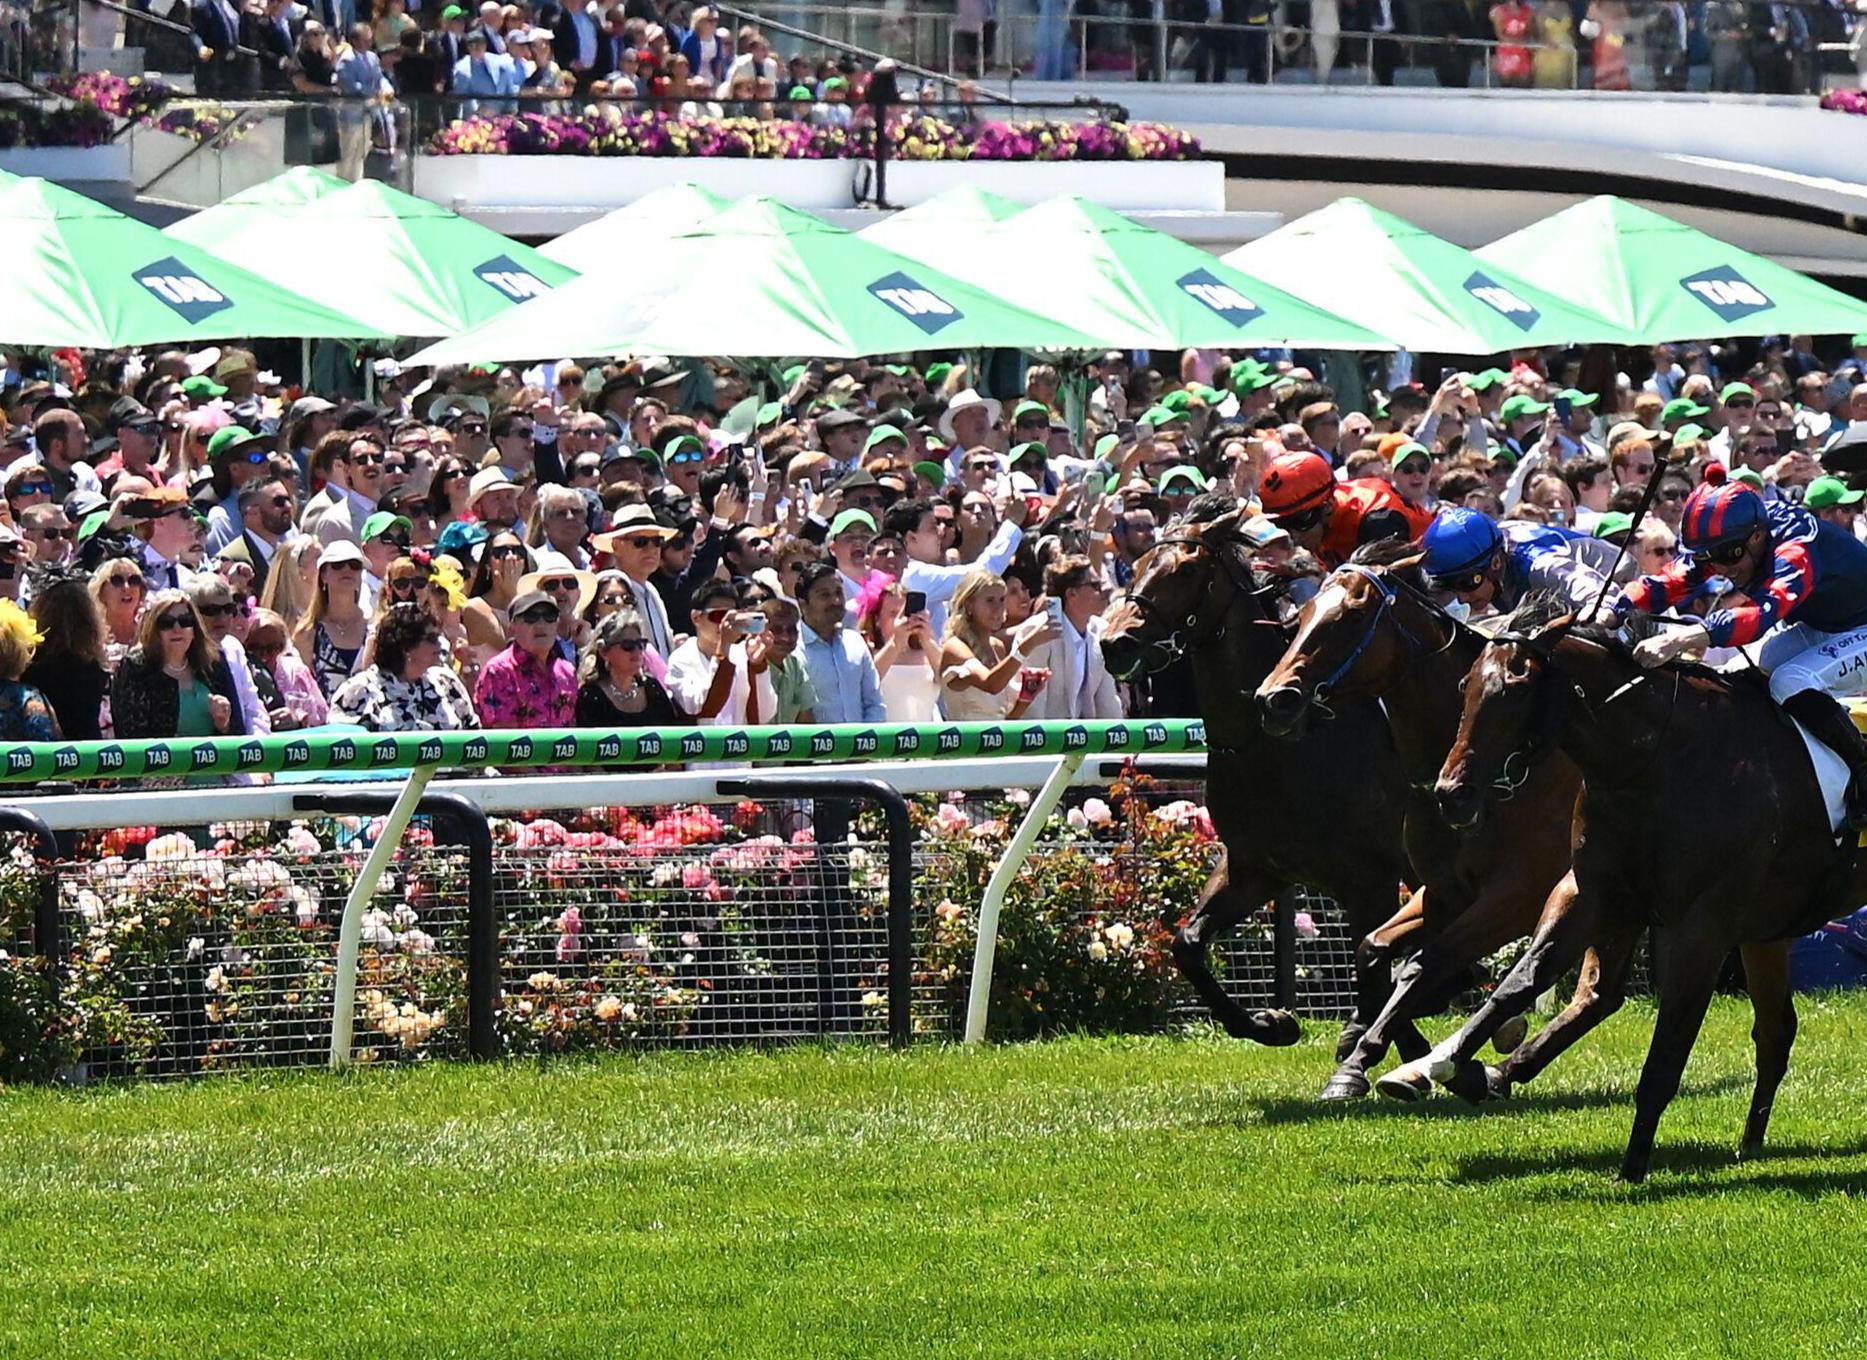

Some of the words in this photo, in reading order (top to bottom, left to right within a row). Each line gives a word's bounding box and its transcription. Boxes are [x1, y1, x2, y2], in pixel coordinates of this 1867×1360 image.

[142, 276, 224, 303] TAB
[875, 288, 954, 315] TAB
[1687, 280, 1767, 305] TAB
[10, 754, 31, 766] TAB
[56, 753, 77, 766] TAB
[100, 752, 122, 765] TAB
[148, 751, 168, 763] TAB
[195, 750, 215, 762] TAB
[241, 749, 261, 761] TAB
[287, 748, 307, 760] TAB
[333, 747, 353, 759] TAB
[376, 747, 395, 759] TAB
[421, 747, 440, 758] TAB
[466, 746, 485, 758] TAB
[511, 745, 530, 757] TAB
[556, 745, 574, 756] TAB
[600, 744, 618, 755] TAB
[640, 741, 659, 753] TAB
[684, 740, 702, 752] TAB
[727, 740, 747, 752] TAB
[771, 740, 789, 751] TAB
[814, 739, 832, 750] TAB
[857, 738, 875, 749] TAB
[898, 736, 917, 748] TAB
[941, 735, 958, 747] TAB
[983, 735, 1001, 746] TAB
[1025, 734, 1043, 745] TAB
[1067, 733, 1085, 744] TAB
[1108, 732, 1126, 743] TAB
[1146, 729, 1165, 741] TAB
